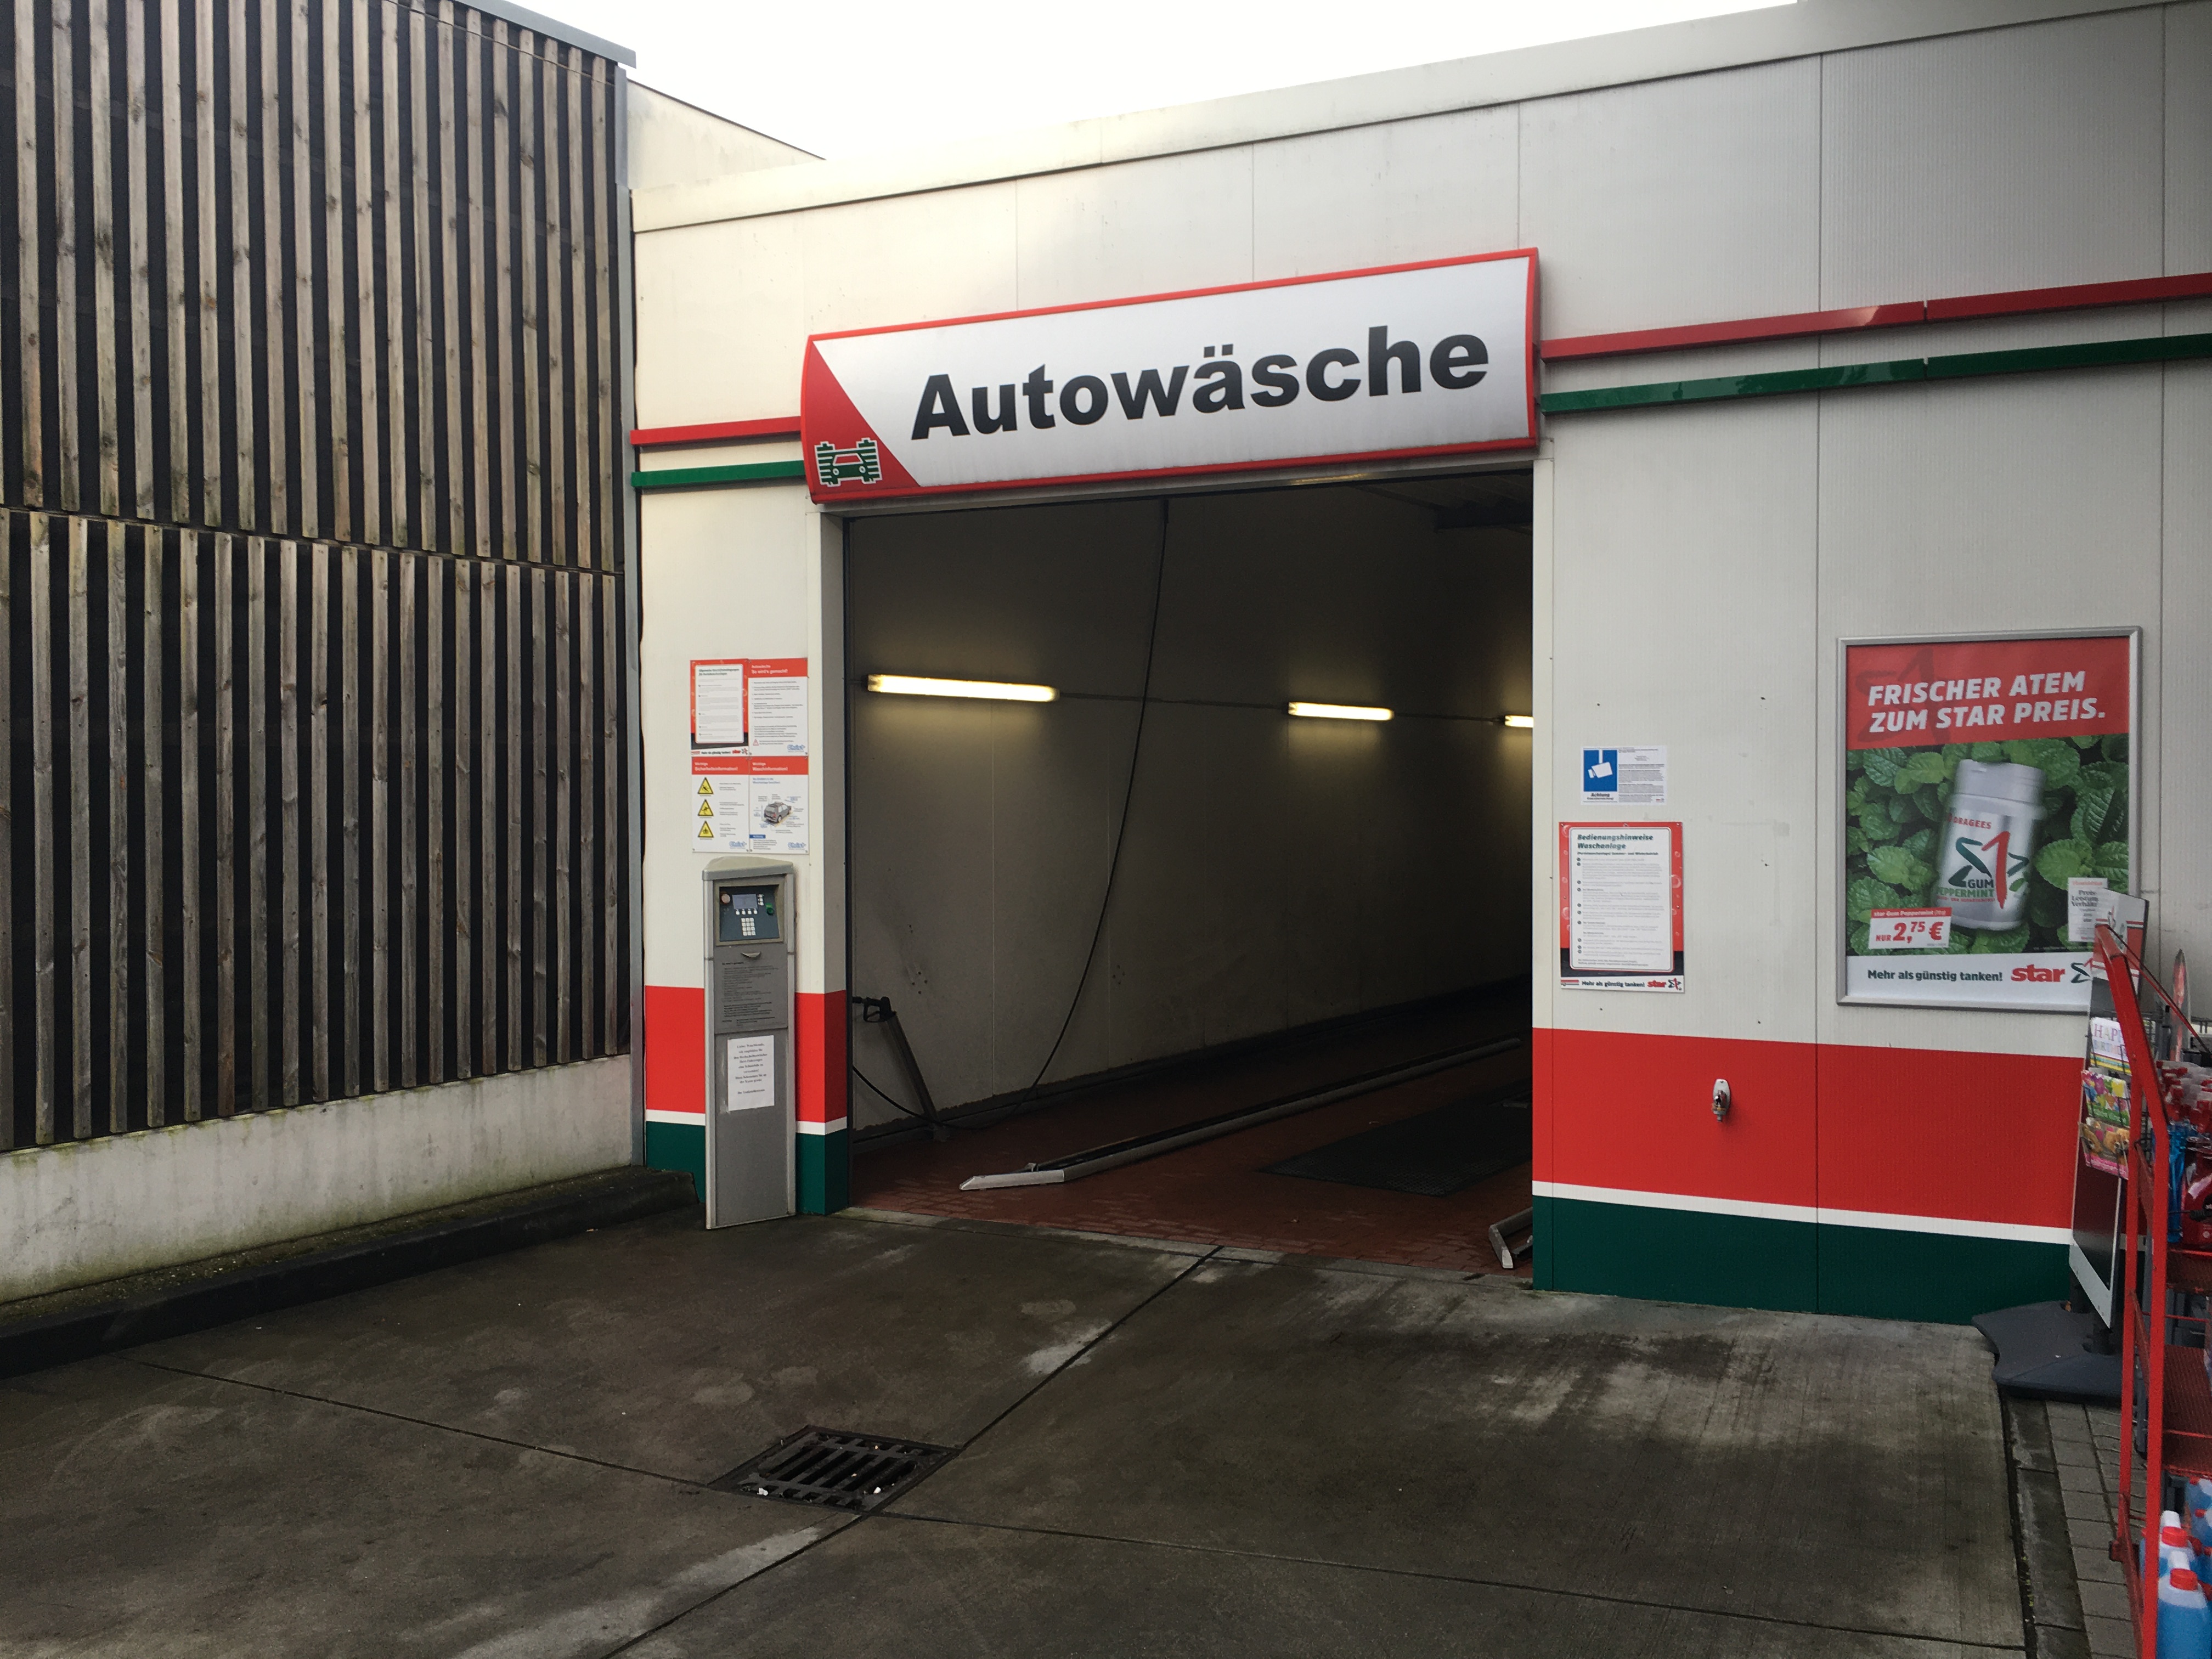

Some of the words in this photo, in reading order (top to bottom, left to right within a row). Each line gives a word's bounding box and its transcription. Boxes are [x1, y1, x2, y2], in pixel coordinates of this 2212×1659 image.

[911, 325, 1489, 440] Autowäsche
[1868, 677, 2001, 706] FRISCHER
[2008, 671, 2085, 697] ATEM
[1869, 709, 1928, 732] ZUM
[1936, 704, 2006, 729] STAR
[2013, 698, 2105, 724] PREIS.
[1953, 816, 1991, 830] DRAGEES
[1577, 833, 1654, 842] Bedienungshinweise
[1968, 879, 1994, 888] GUM
[1893, 921, 1926, 944] 2,75
[1929, 922, 1944, 940] €
[1867, 970, 1895, 979] Mehr
[1898, 970, 1914, 979] als
[1916, 970, 1957, 981] günstig
[1960, 972, 2002, 981] tanken!
[2011, 964, 2065, 983] star
